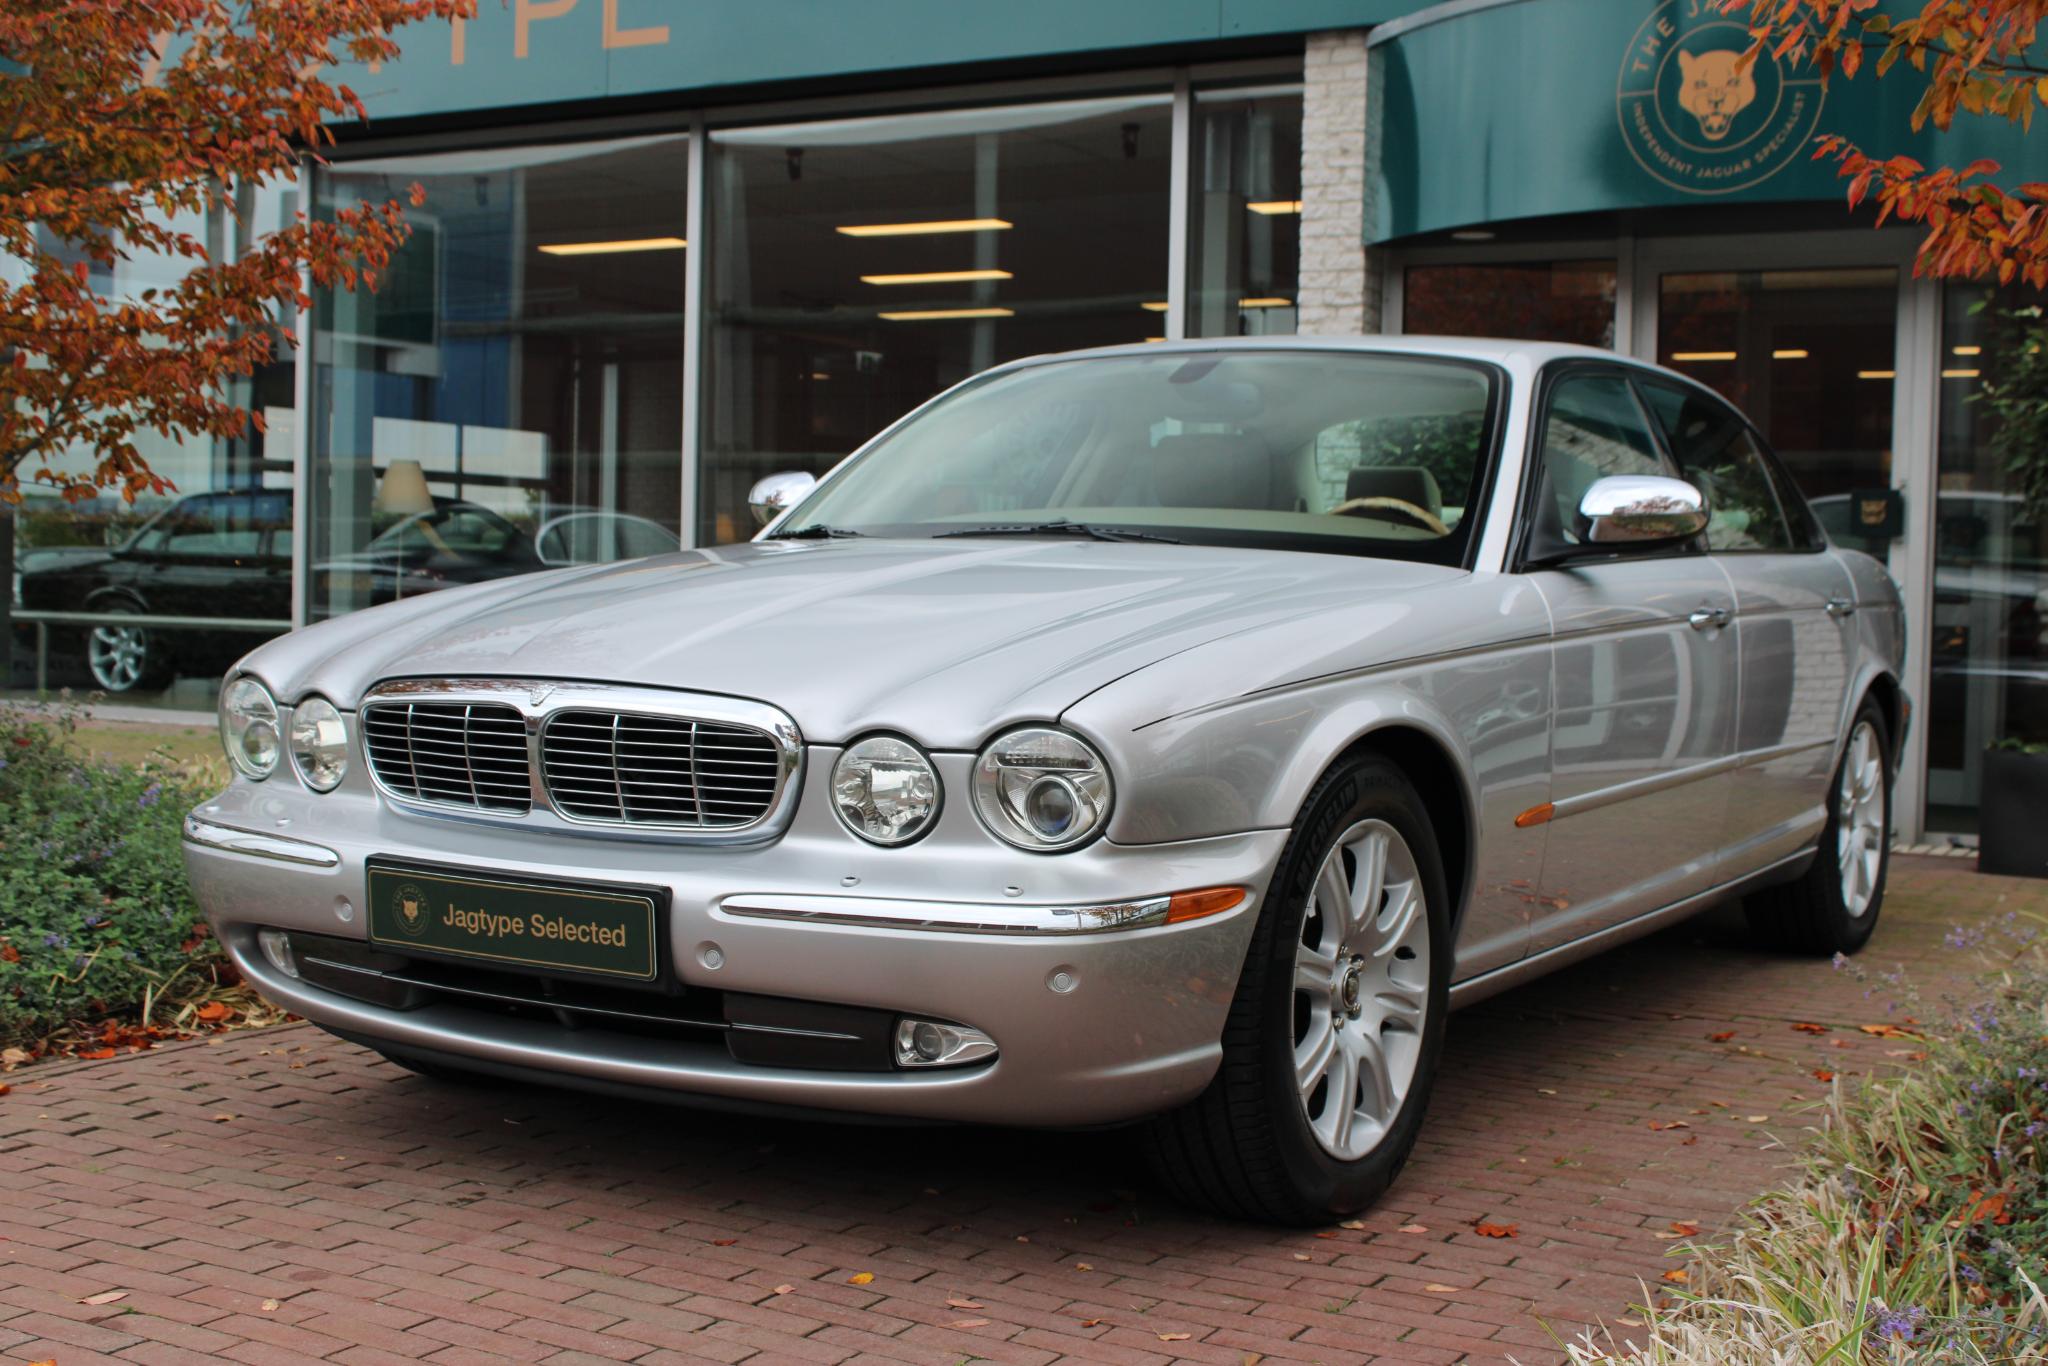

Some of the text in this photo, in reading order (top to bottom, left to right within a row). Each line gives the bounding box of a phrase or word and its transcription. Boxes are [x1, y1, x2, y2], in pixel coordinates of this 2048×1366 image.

[1632, 17, 1675, 73] THE
[1634, 92, 1805, 178] INDEPENDENT JAGUAR SPECIALIST
[443, 903, 525, 938] Jagtype
[530, 914, 626, 947] Selected
